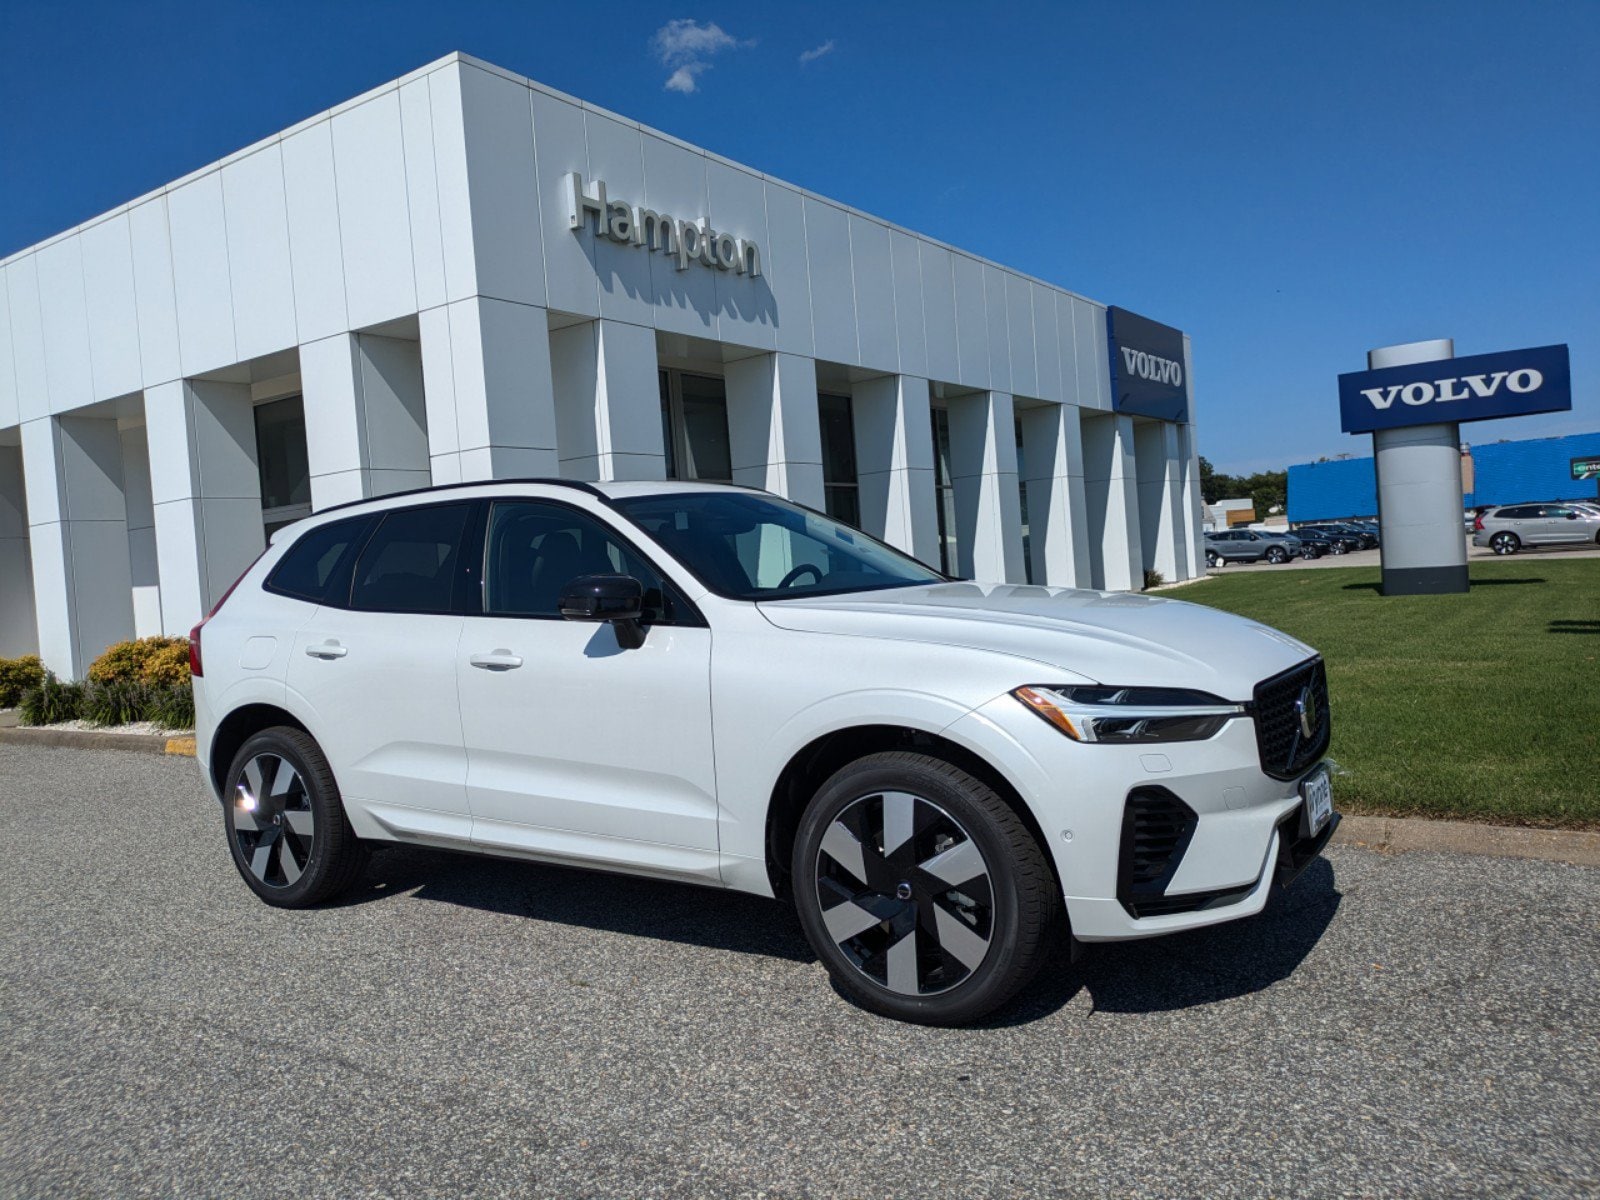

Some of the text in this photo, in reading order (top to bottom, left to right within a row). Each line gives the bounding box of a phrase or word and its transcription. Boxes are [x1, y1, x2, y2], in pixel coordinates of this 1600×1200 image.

[565, 171, 762, 278] Hampton
[1121, 346, 1182, 387] VOLVO
[1360, 368, 1544, 410] VOLVO
